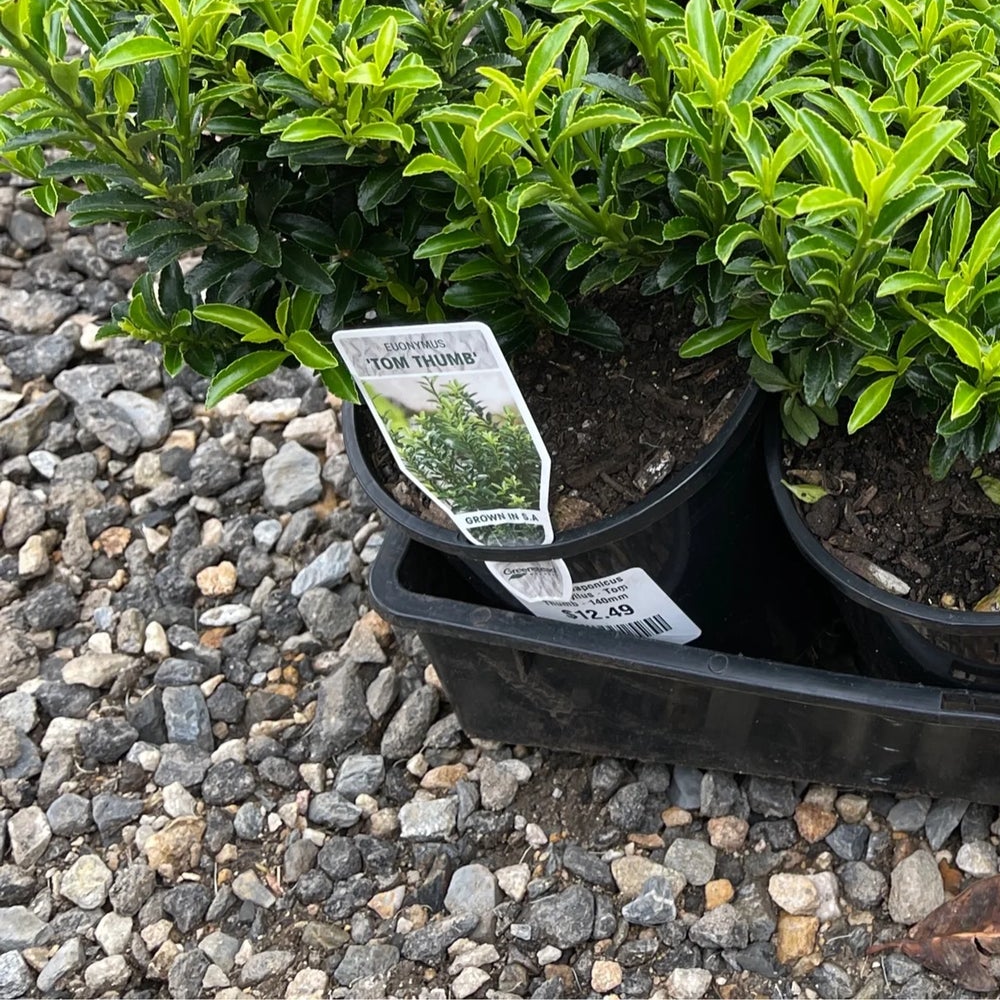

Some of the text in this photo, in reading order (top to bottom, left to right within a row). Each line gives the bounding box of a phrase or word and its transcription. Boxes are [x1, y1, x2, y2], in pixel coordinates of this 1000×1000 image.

[384, 339, 446, 352] EUONYMUS
[366, 352, 477, 371] 'TOM THUMB'
[465, 513, 506, 525] GROWN
[602, 584, 628, 595] Tom
[589, 593, 629, 606] 140mm
[561, 604, 635, 620] $12.49
